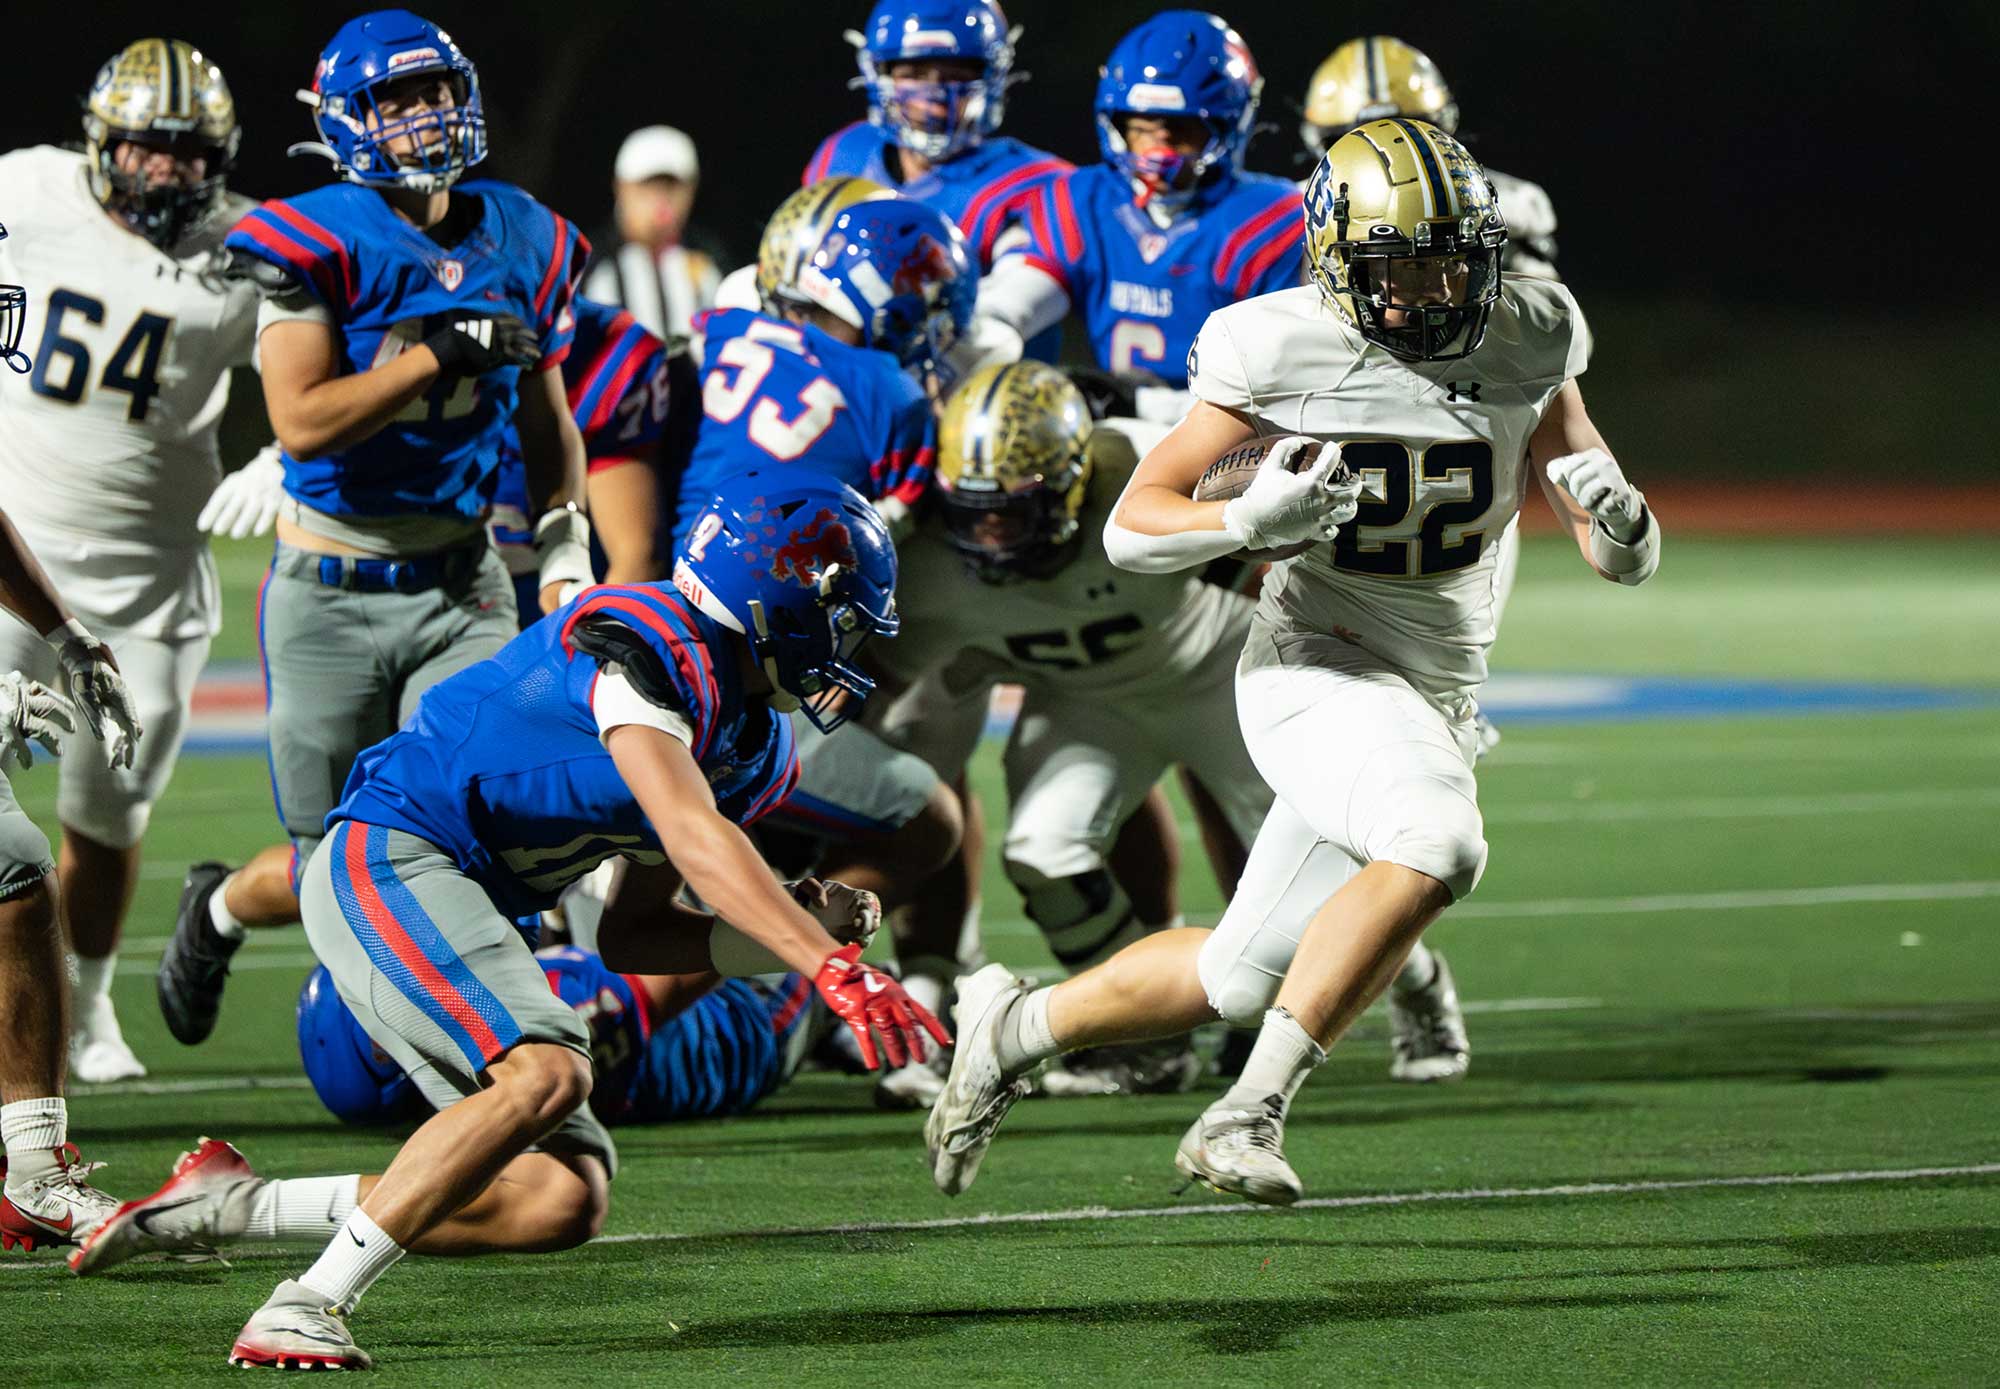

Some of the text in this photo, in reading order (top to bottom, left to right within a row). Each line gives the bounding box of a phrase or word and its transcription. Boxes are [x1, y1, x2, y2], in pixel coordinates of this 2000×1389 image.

[28, 287, 175, 425] 64
[703, 319, 849, 463] 53
[1332, 438, 1495, 580] 22
